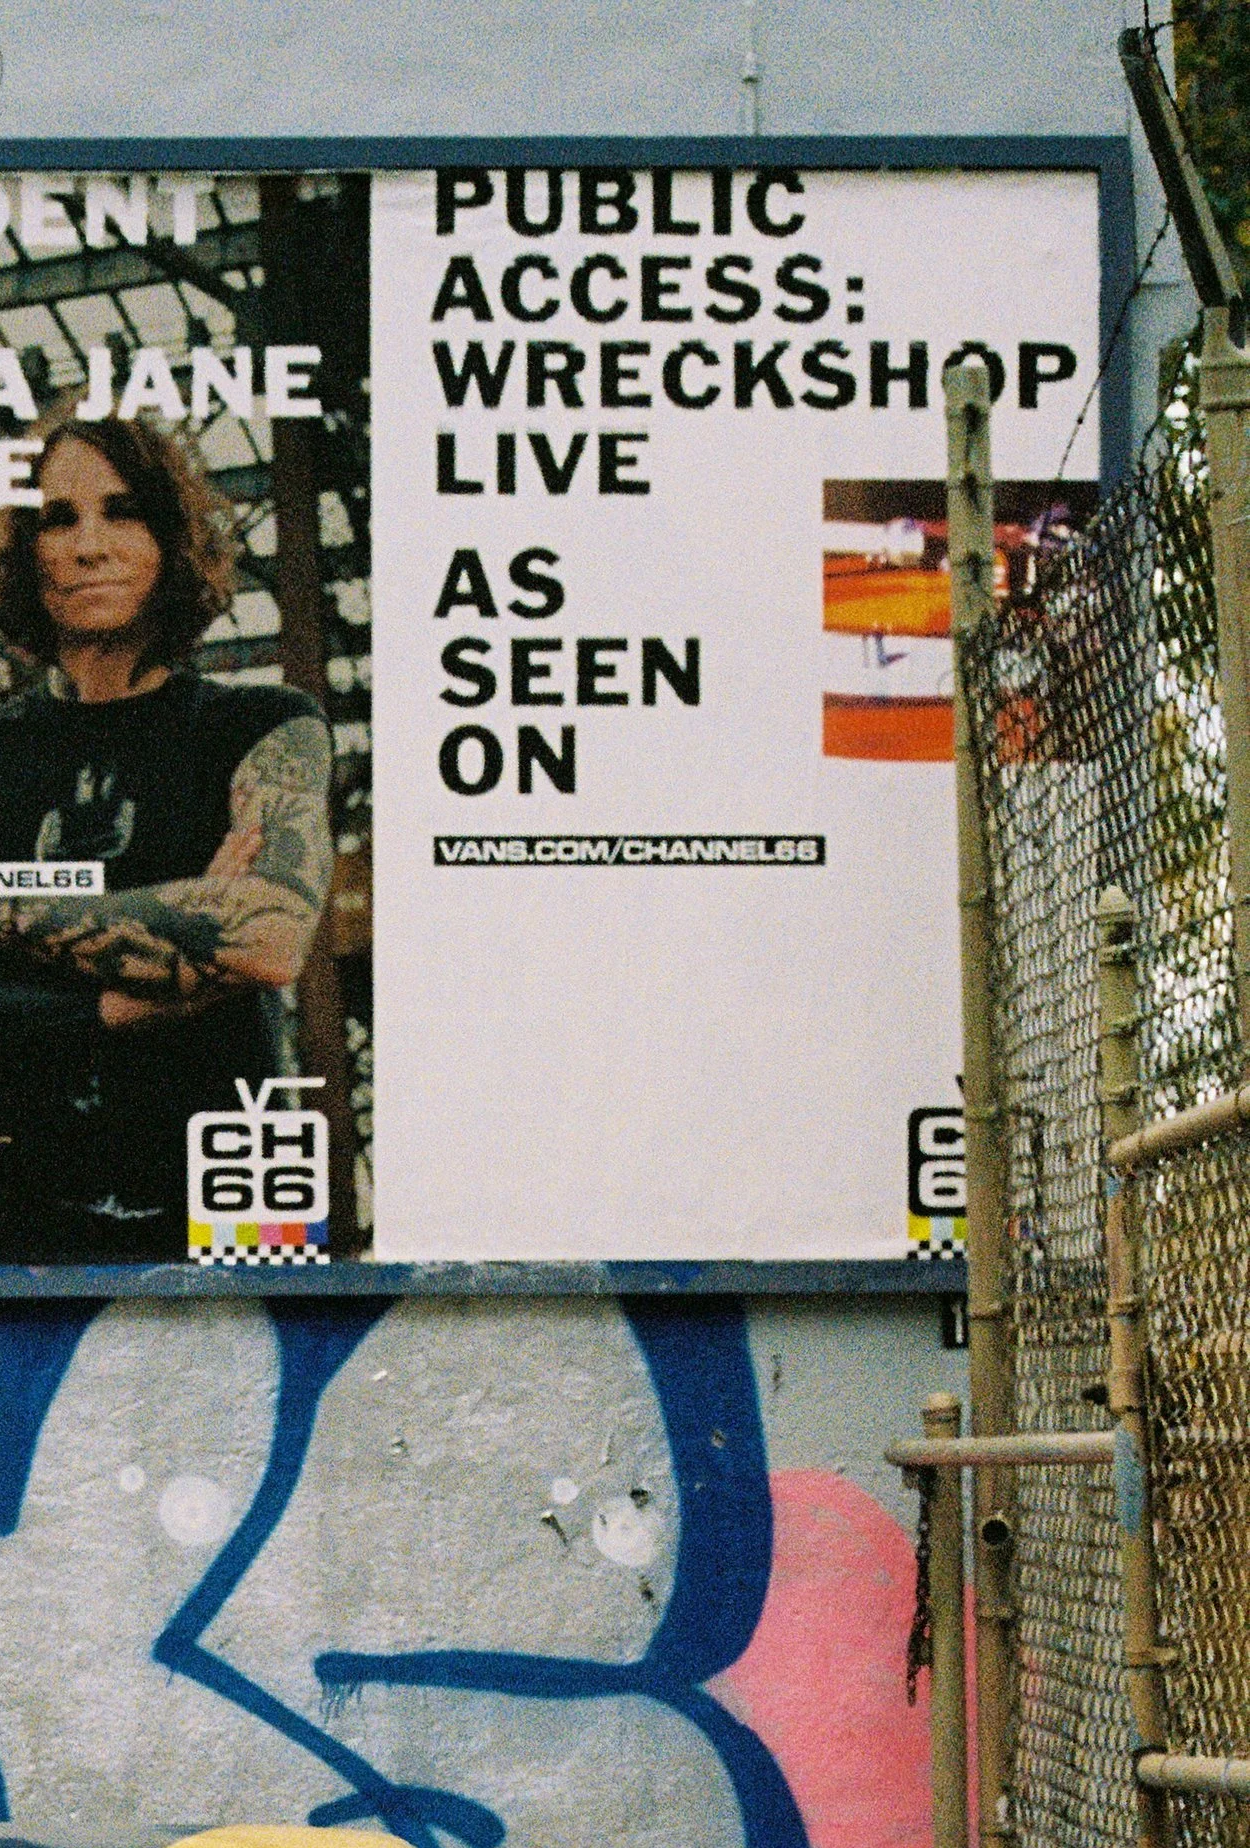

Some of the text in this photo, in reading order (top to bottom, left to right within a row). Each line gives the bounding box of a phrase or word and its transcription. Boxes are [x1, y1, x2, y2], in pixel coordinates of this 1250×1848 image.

[435, 167, 806, 238] PUBLIC
[430, 253, 864, 324] ACCESS:
[76, 345, 323, 420] JANE
[436, 432, 650, 495] LIVE
[434, 547, 566, 619] AS
[439, 637, 701, 707] SEEN
[438, 723, 577, 796] ON
[438, 839, 819, 862] VANS.COM/CHANNEL66
[202, 1122, 315, 1160] CH
[202, 1166, 315, 1212] 66
